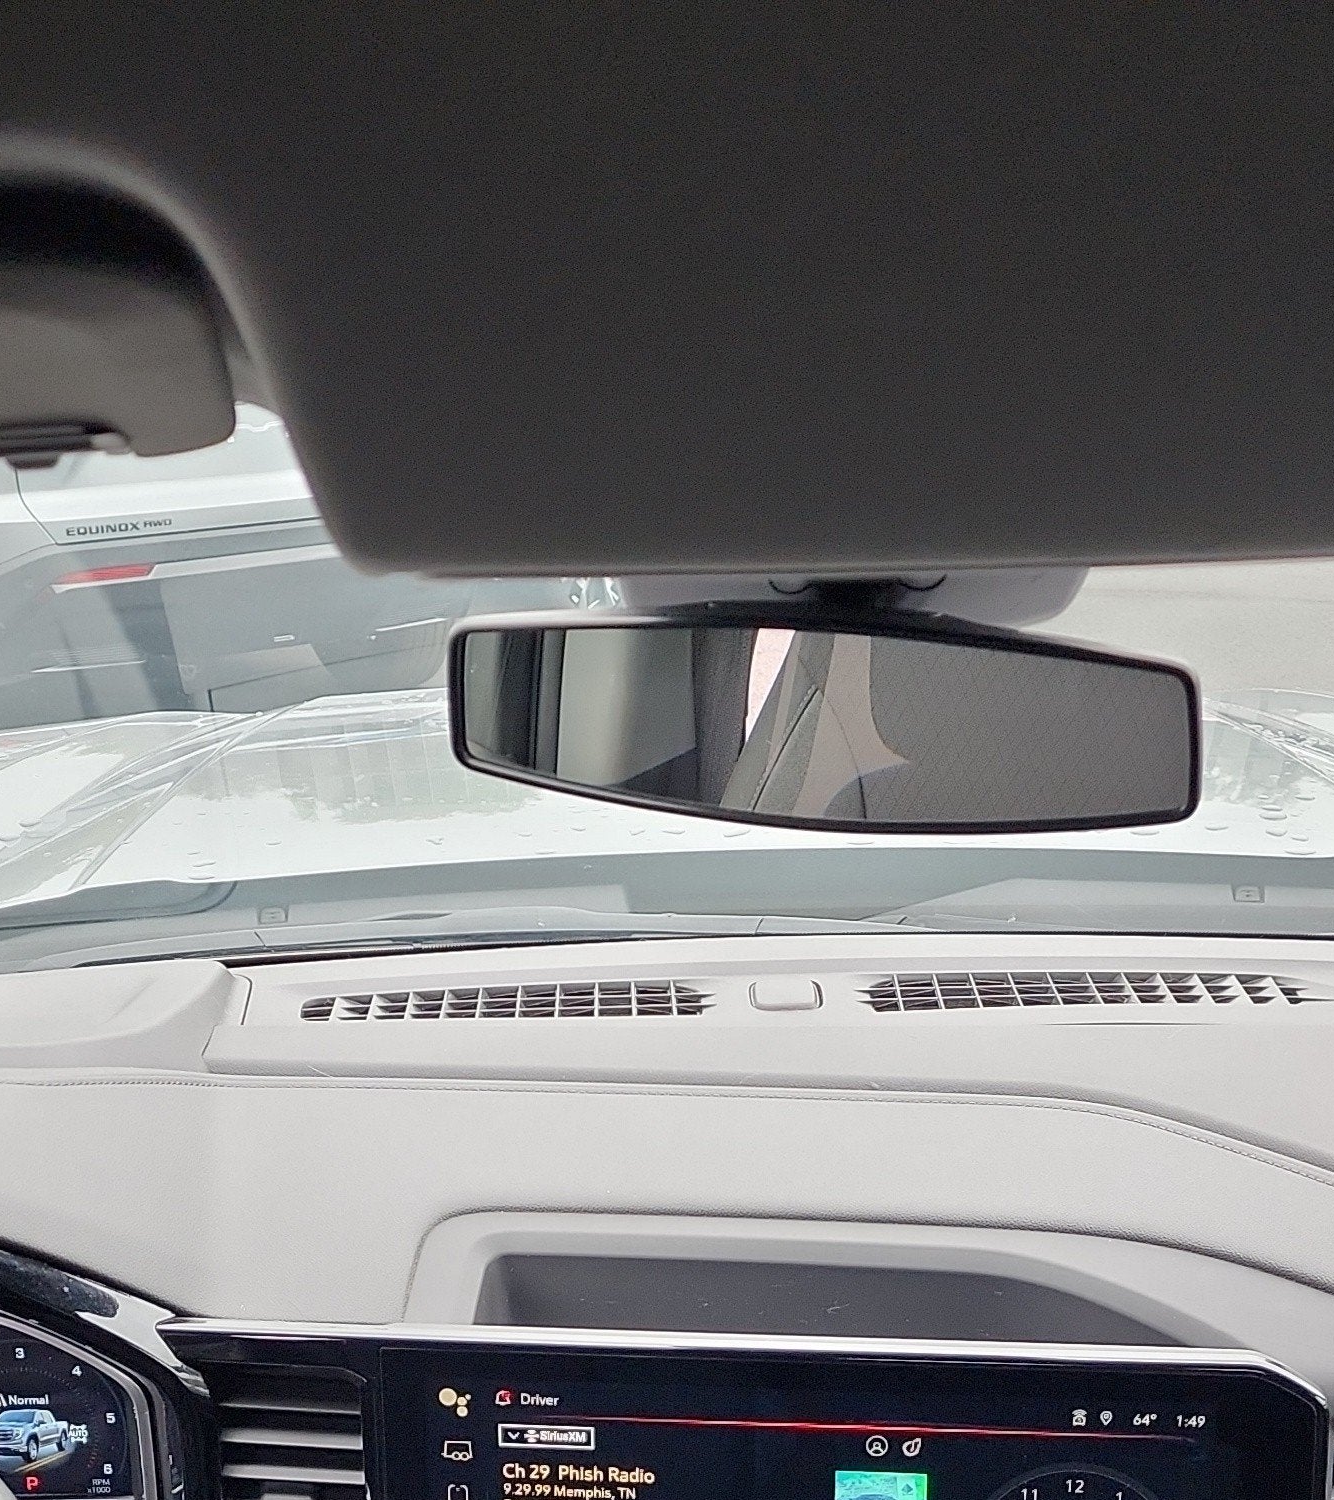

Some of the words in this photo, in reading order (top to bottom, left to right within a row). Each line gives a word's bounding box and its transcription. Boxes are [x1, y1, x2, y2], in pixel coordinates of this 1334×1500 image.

[65, 521, 141, 536] EQUINOX
[15, 1348, 25, 1359] 3
[71, 1366, 83, 1377] 4
[8, 1394, 50, 1406] Normal
[520, 1392, 560, 1406] Driver
[105, 1412, 116, 1424] 5
[1176, 1414, 1206, 1428] 1:49
[540, 1430, 588, 1443] SiriusXM
[103, 1464, 113, 1475] 6
[502, 1463, 526, 1479] Ch
[529, 1464, 550, 1480] 29
[558, 1464, 604, 1483] Phish
[608, 1466, 656, 1484] Radio
[26, 1476, 38, 1490] P
[92, 1478, 110, 1486] RPM
[1065, 1479, 1085, 1494] 12
[503, 1482, 552, 1496] 9.29.99
[553, 1484, 616, 1500] Memphis,
[618, 1487, 637, 1500] TN
